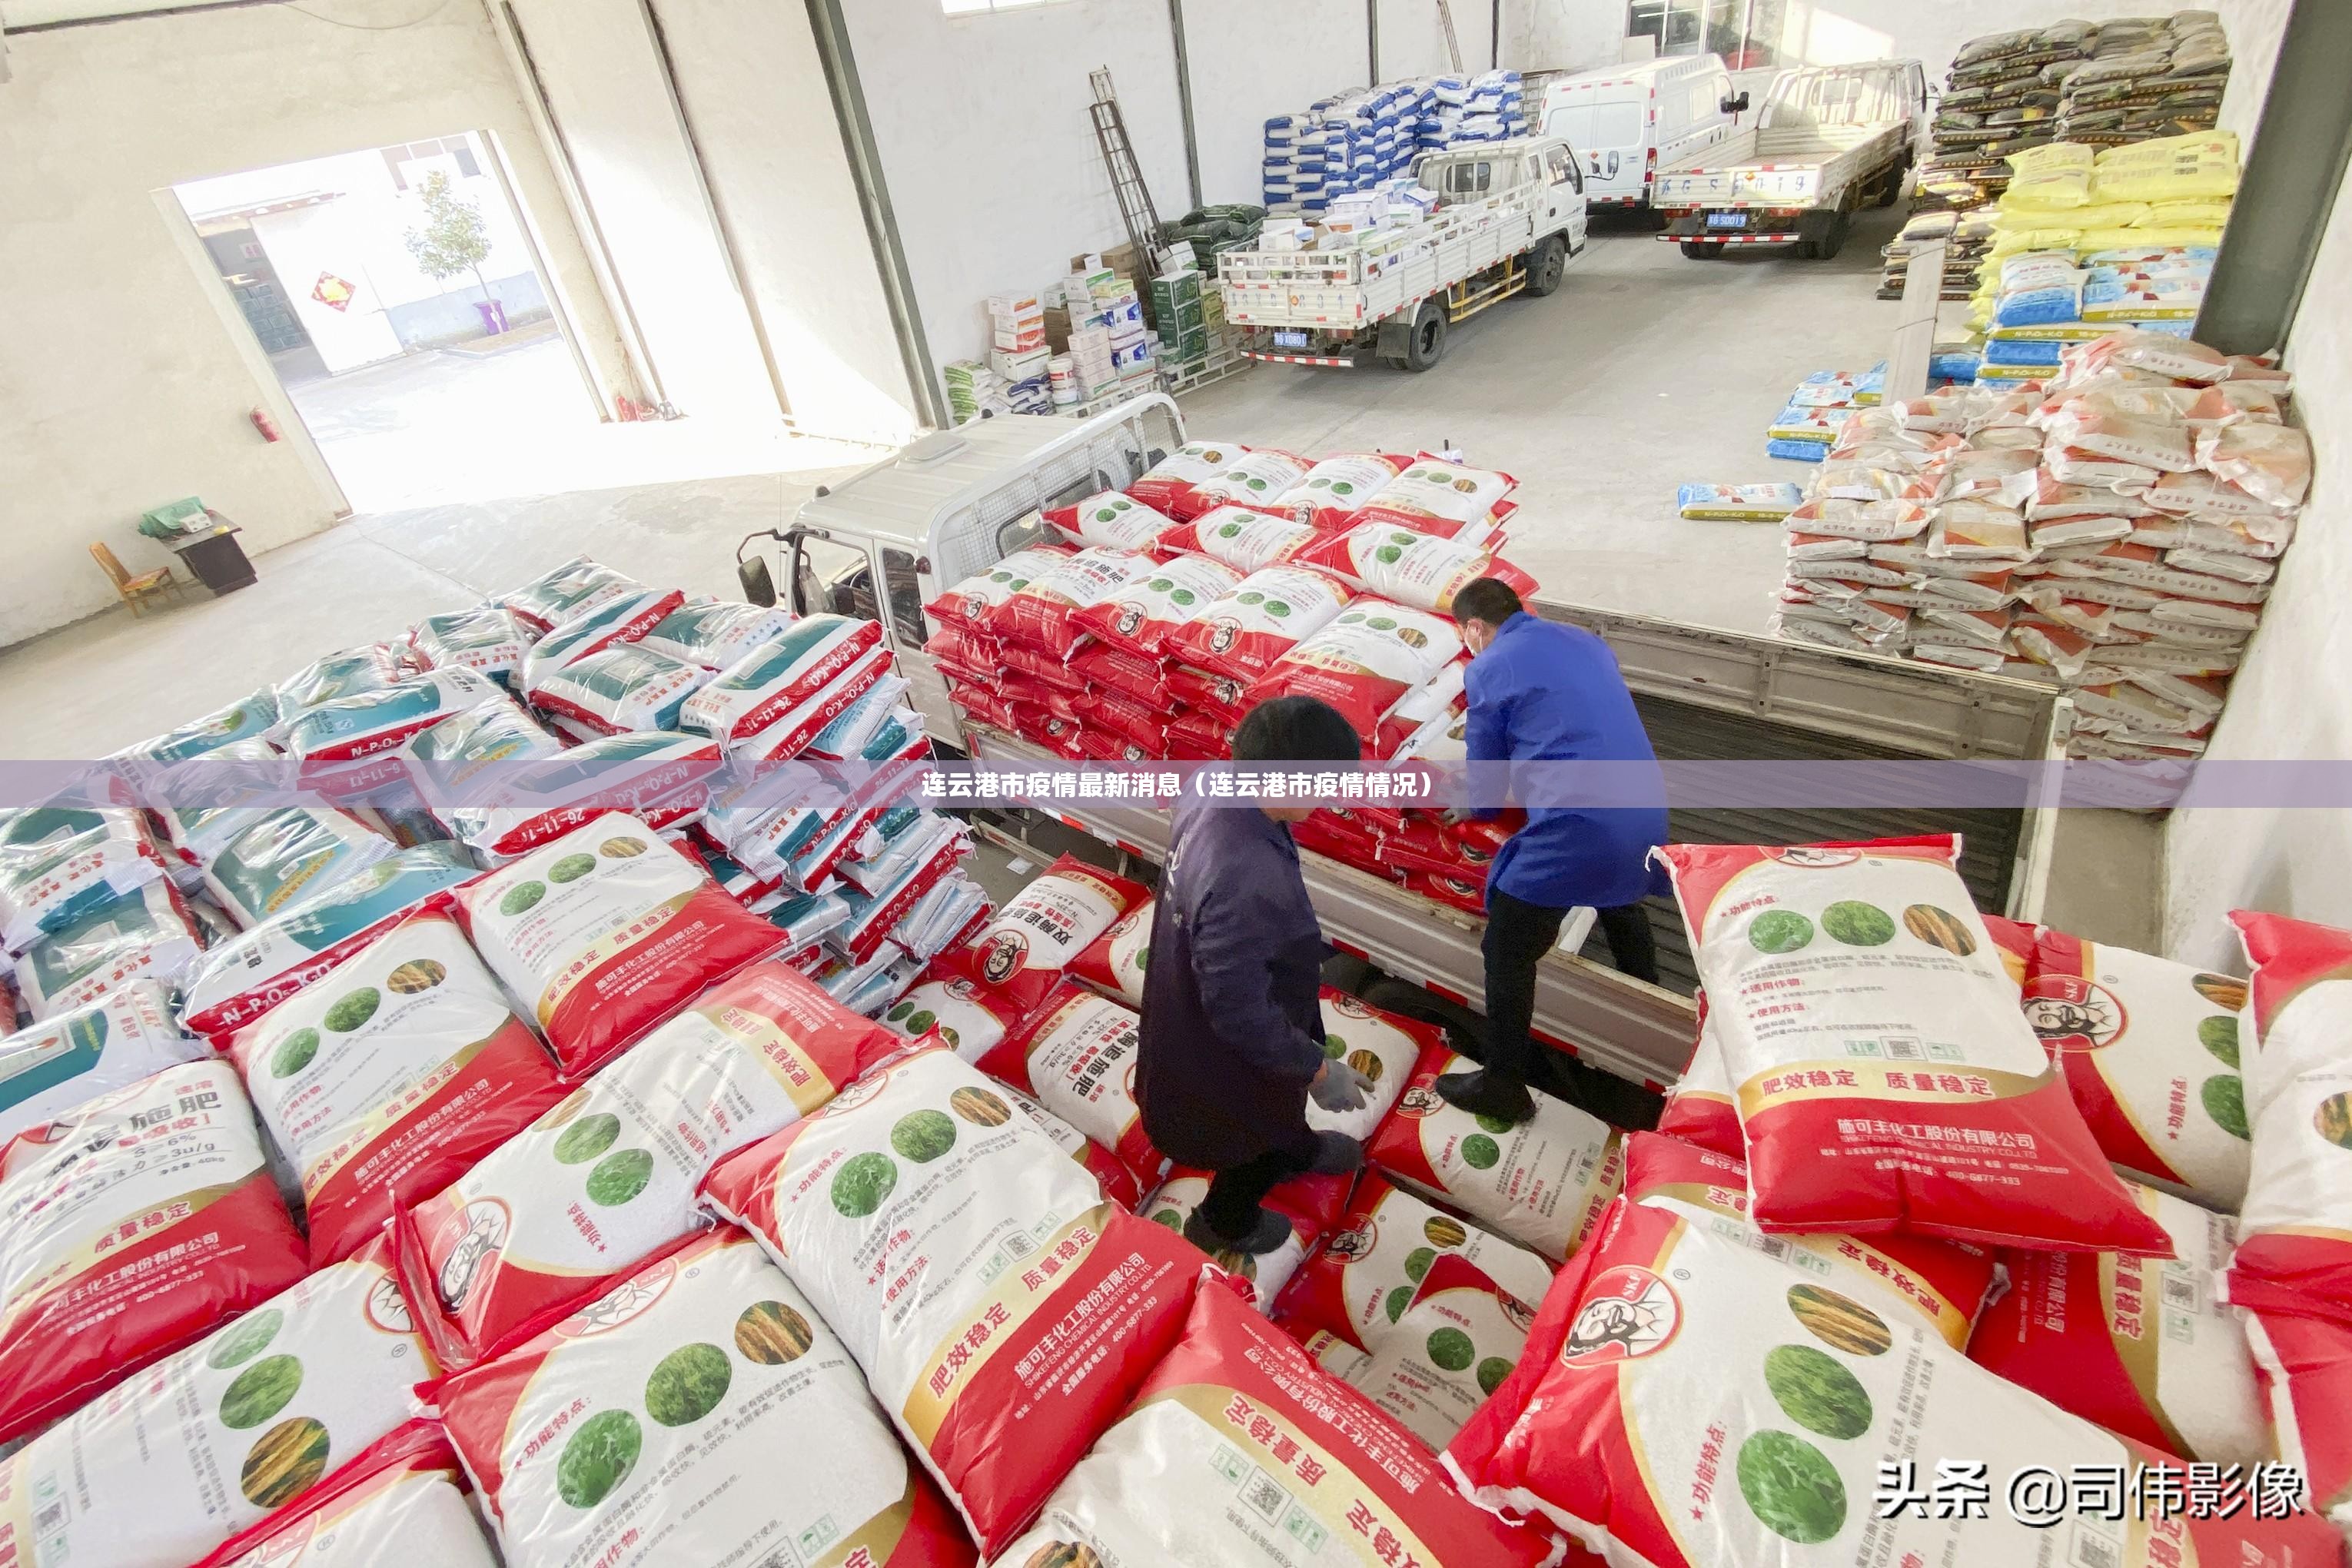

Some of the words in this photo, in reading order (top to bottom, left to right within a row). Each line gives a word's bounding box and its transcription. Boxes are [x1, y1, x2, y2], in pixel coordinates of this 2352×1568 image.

[612, 905, 676, 945] 质量稳定
[385, 1060, 460, 1118] 质量稳定
[762, 1038, 812, 1088] 肥效稳定
[1760, 1068, 1859, 1098] 肥效稳定
[1885, 1069, 1998, 1099] 质量稳定
[353, 1076, 491, 1181] 施可丰化工股份有限公司
[1836, 1117, 2036, 1151] 施可丰化工股份有限公司
[797, 1145, 849, 1195] 功能特点：
[93, 1200, 194, 1255] 质量稳定
[566, 1200, 603, 1247] 功能特点：
[54, 1230, 221, 1311] 可丰化工股份有限公司
[884, 1254, 935, 1304] 使用方法：
[927, 1301, 1014, 1401] 肥效稳定
[1019, 1224, 1099, 1294] 质量稳定
[1012, 1251, 1147, 1383] 施可丰化工股份有限公司
[1096, 1284, 1130, 1317] INDUSTRY
[1111, 1295, 1159, 1344] 400-6877-333
[521, 1395, 593, 1461] 功能特点：
[1220, 1392, 1329, 1490] 质量稳定
[1244, 1347, 1422, 1497] 施可丰化工股份有限公司
[1691, 1418, 1728, 1507] 功能特点：
